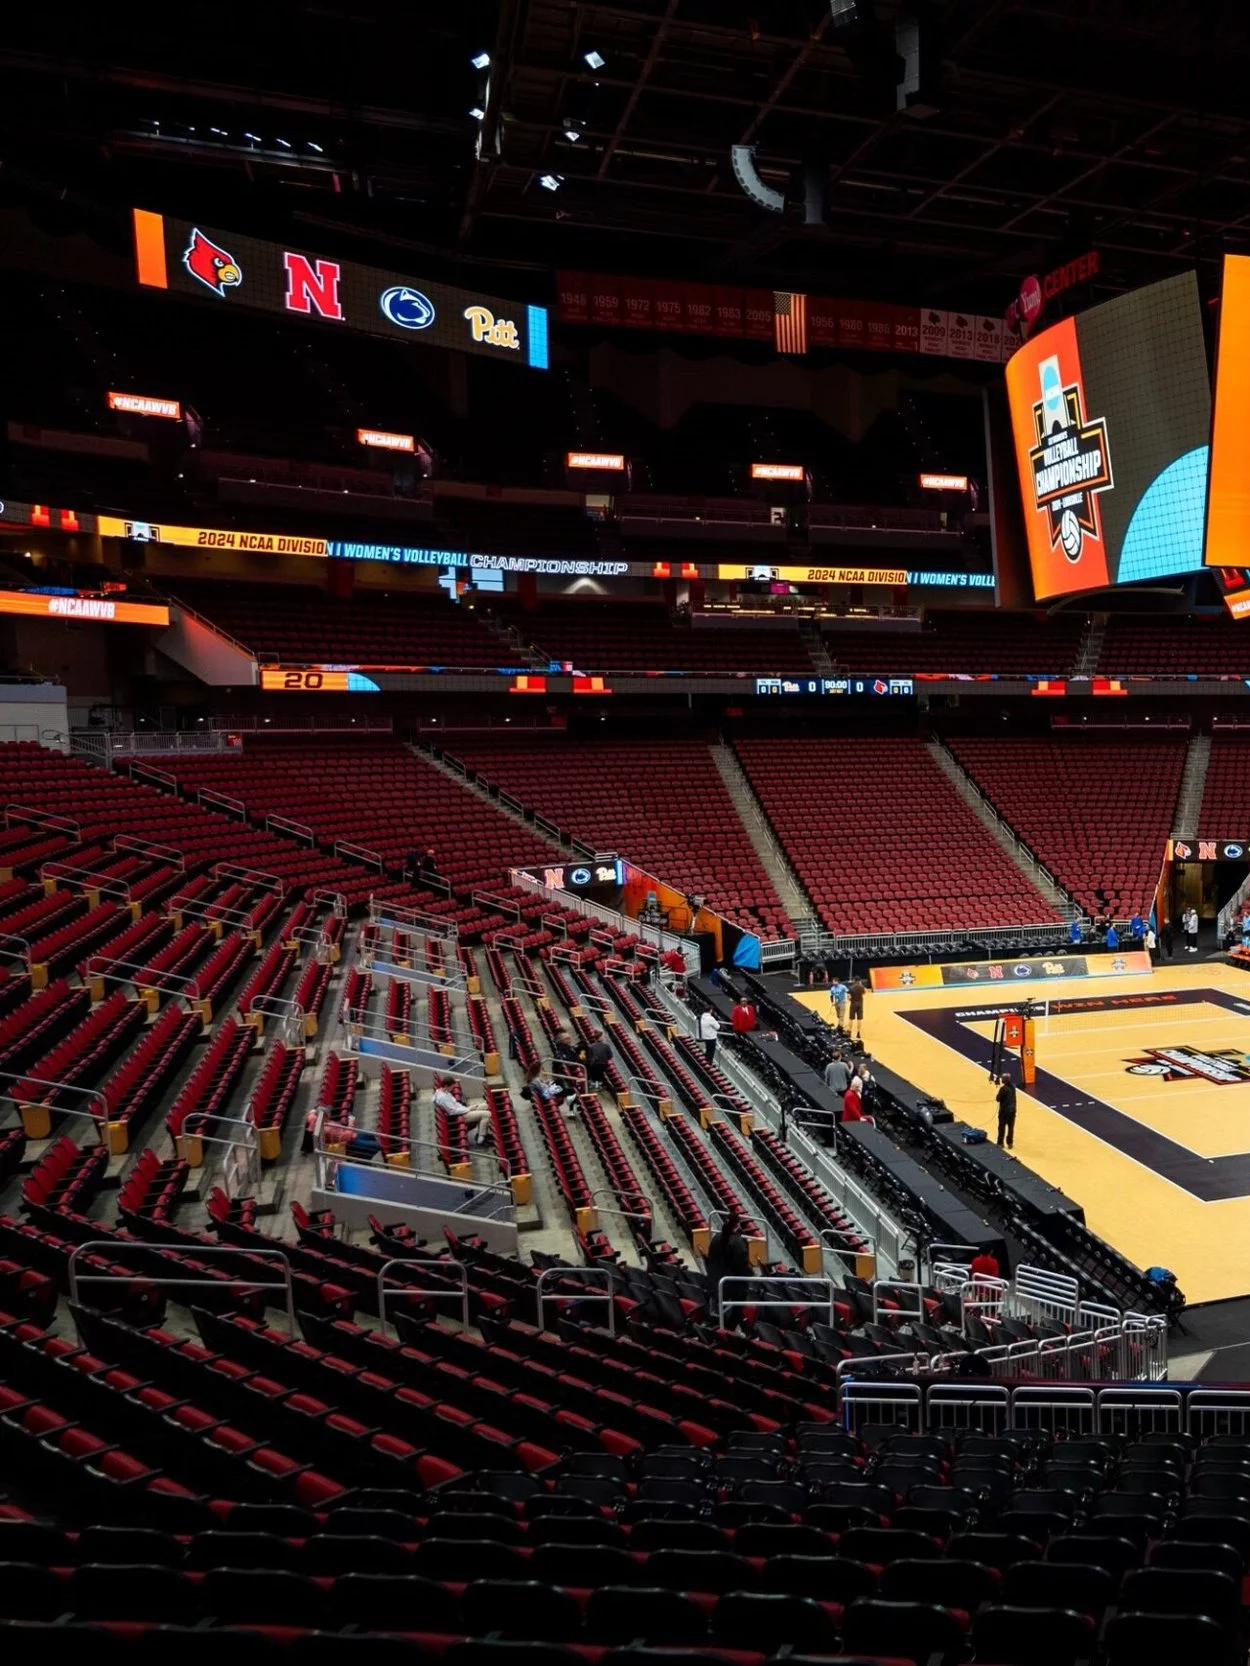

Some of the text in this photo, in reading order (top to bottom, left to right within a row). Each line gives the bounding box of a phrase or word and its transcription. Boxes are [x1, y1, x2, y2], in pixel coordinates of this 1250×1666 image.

[1044, 251, 1100, 298] CENTER
[284, 251, 342, 320] N
[464, 305, 520, 350] Pitt
[894, 324, 919, 337] 2013
[922, 325, 946, 337] 2009
[949, 328, 973, 341] 2013
[1036, 449, 1101, 497] CHAMPIONSHIP
[198, 531, 235, 548] 2024
[239, 535, 274, 551] NCAA
[344, 543, 400, 560] WOMEN'S
[404, 549, 469, 567] VOLLEYBALL
[469, 554, 629, 575] CHAMPIONSHIP
[807, 569, 837, 581] 2024
[838, 570, 865, 582] NCAA
[919, 572, 968, 586] WOMEN'S
[48, 597, 116, 619] #NCAAWVB
[283, 672, 323, 689] 20
[809, 681, 816, 692] 0
[856, 681, 864, 692] 0
[1198, 842, 1217, 860] N
